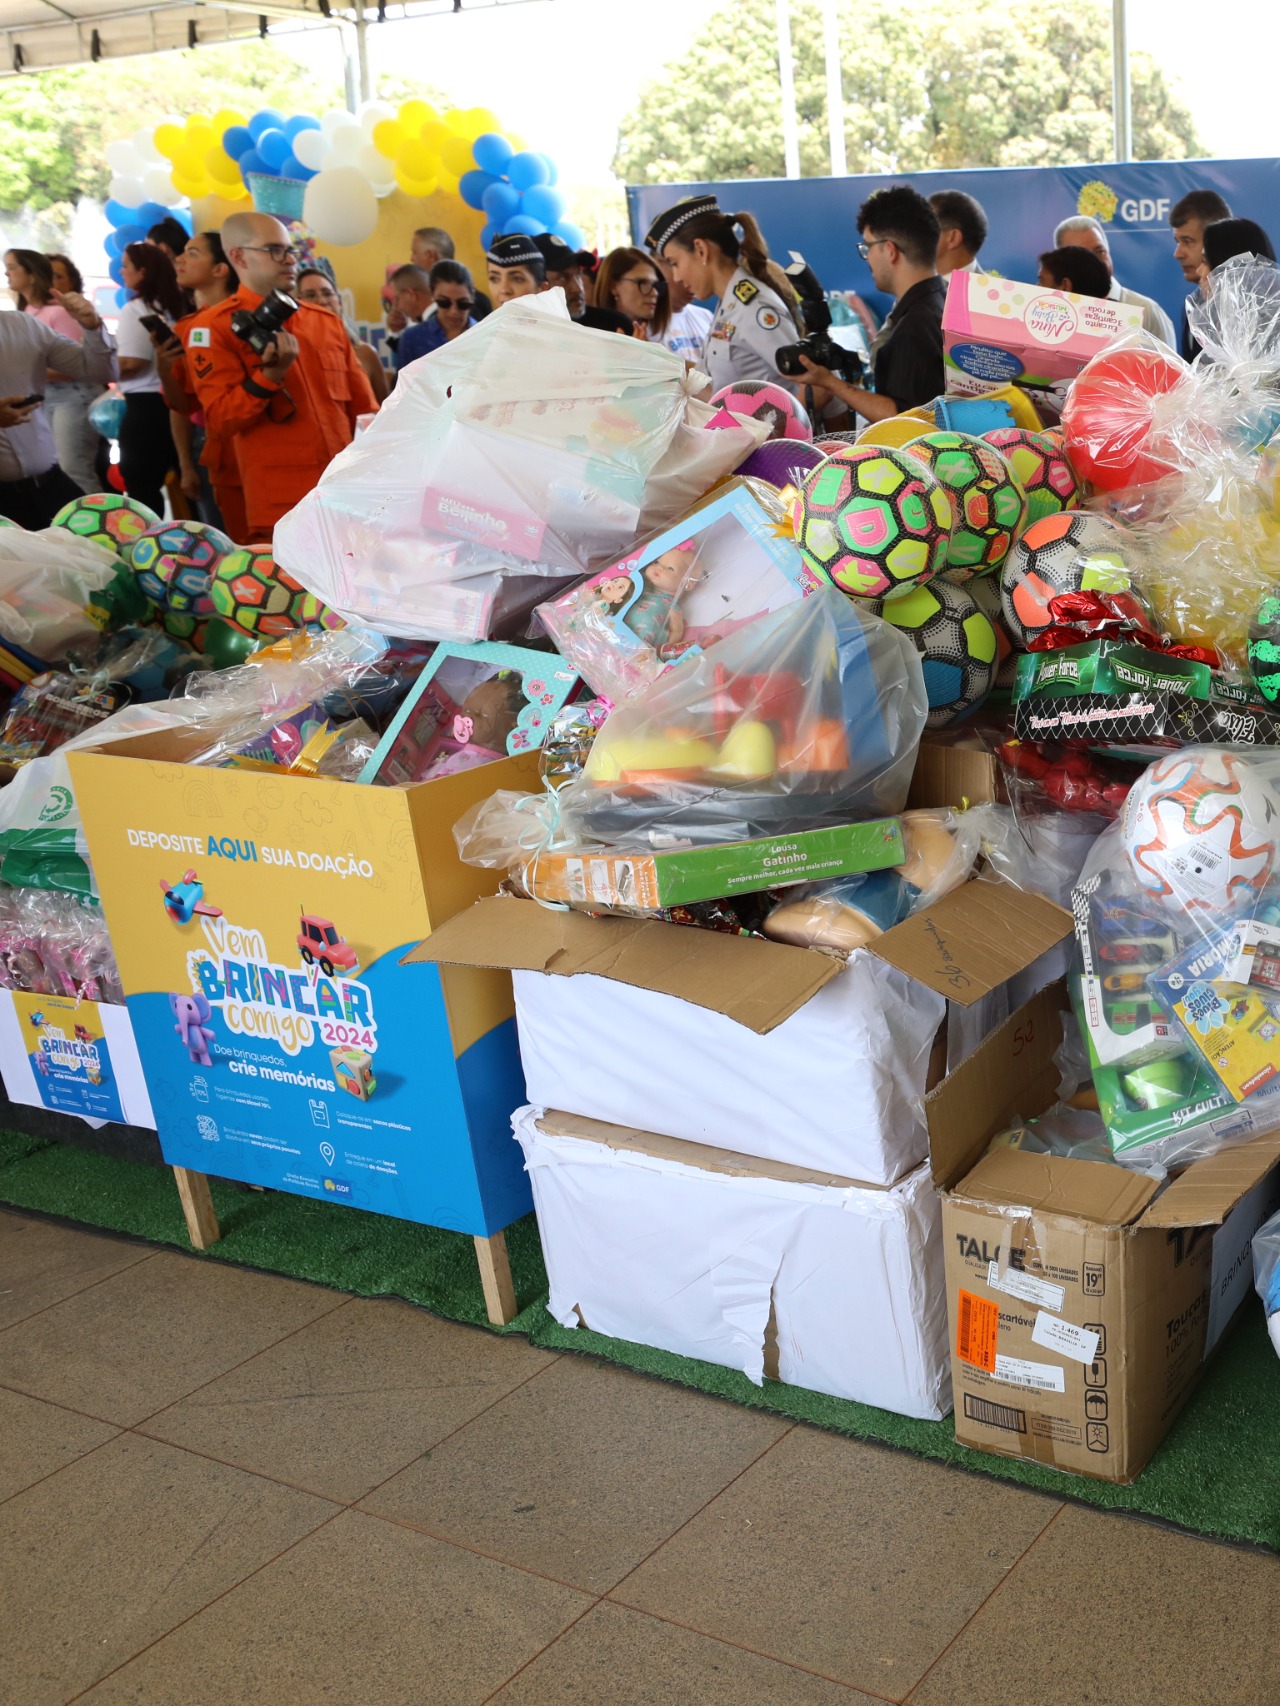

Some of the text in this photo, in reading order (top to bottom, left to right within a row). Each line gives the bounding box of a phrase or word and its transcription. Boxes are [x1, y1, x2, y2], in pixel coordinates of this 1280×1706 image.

[1121, 198, 1170, 222] GDF
[1032, 305, 1058, 322] Baby
[1084, 312, 1118, 324] cantigas
[1088, 306, 1106, 315] roda
[1030, 319, 1075, 338] Nina
[1085, 320, 1118, 333] Eu canto
[438, 503, 507, 532] Beijinho
[1058, 657, 1079, 677] Force
[127, 829, 373, 879] DEPOSITE AQUI SUA DOAÇÃO
[771, 842, 798, 854] Lousa
[728, 858, 844, 885] Sempre melhor, cada vez mais criança
[763, 852, 808, 868] Gatinho
[206, 919, 263, 959] Vem
[197, 957, 373, 1028] BRINCAR
[1188, 988, 1215, 1011] Clues
[1192, 999, 1222, 1023] Blue's
[227, 1004, 374, 1051] comigo 2024
[42, 1039, 98, 1060] BRINCAR
[214, 1043, 287, 1067] Doe brinquedos,
[229, 1060, 336, 1092] crie memórias
[1242, 1065, 1273, 1091] nickelodeon
[1172, 1107, 1192, 1123] KIT
[336, 1184, 350, 1193] GDF
[1166, 1290, 1207, 1339] Toucas
